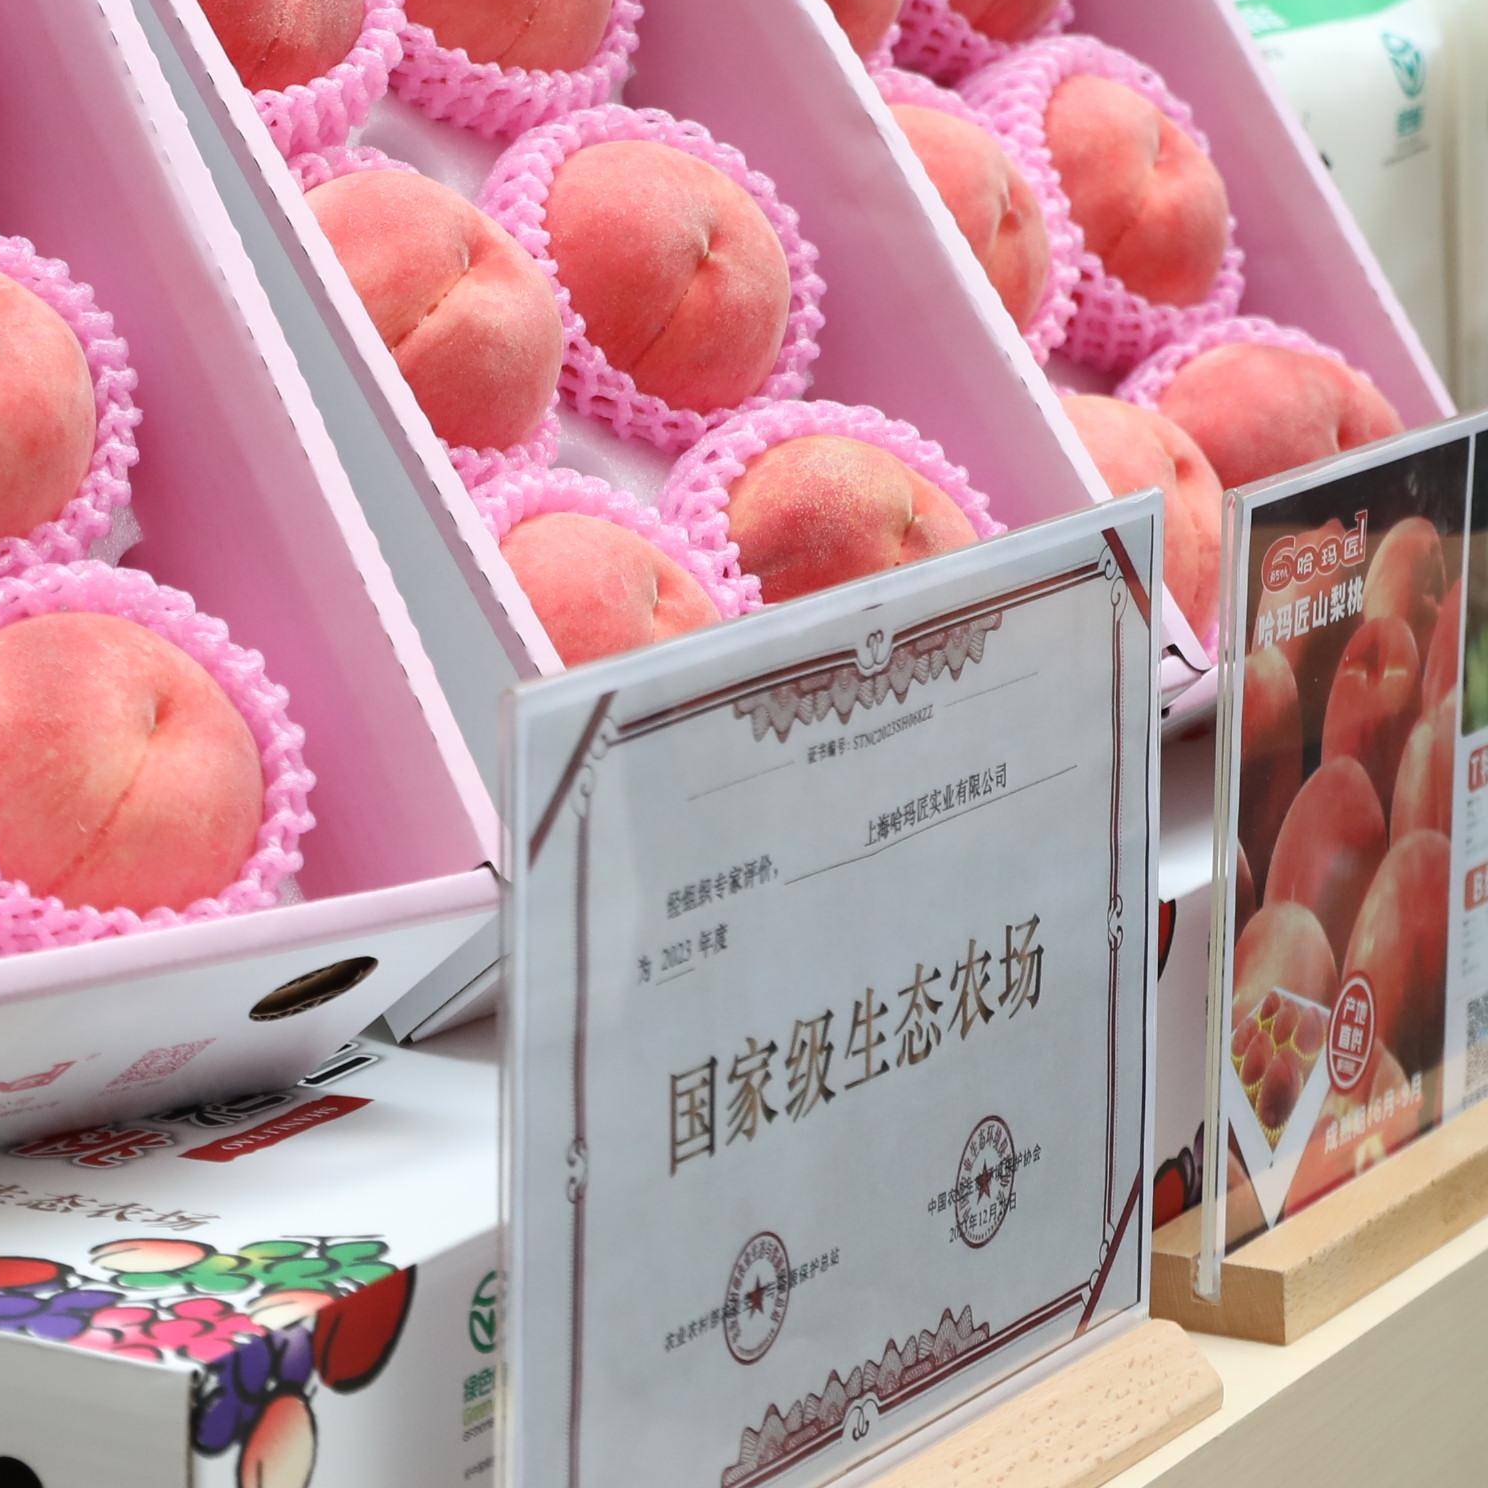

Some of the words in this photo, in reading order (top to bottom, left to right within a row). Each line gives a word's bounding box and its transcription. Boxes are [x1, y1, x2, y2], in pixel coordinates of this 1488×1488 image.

[1296, 535, 1360, 576] 哈玛匠
[1257, 575, 1364, 650] 哈玛匠山梨桃
[863, 762, 1007, 848] 上海哈玛匠实业有限公司
[667, 912, 1045, 1178] 国家级生态农场
